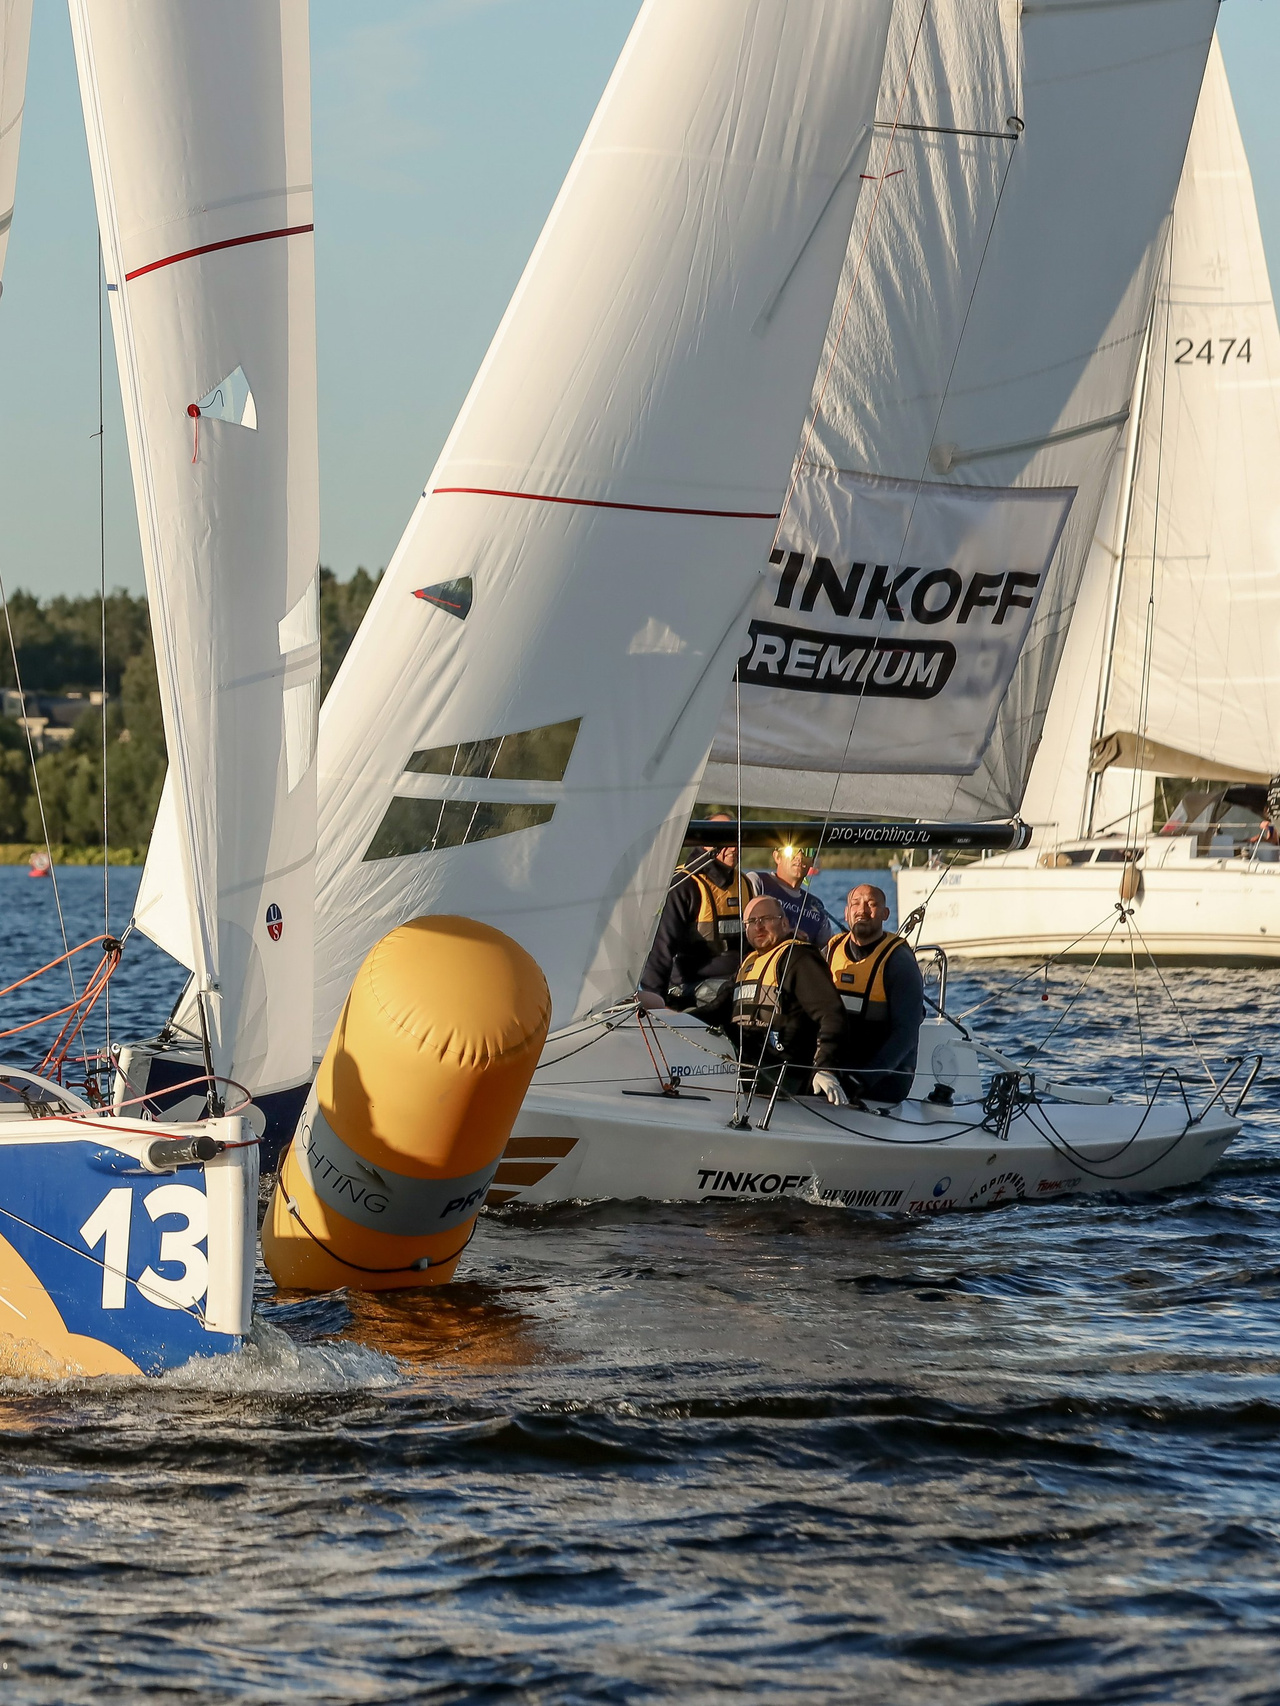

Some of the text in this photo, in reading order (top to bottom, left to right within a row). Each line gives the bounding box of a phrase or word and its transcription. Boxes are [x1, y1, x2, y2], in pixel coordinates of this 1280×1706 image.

[1174, 337, 1252, 365] 2474
[769, 549, 1041, 625] INKOFF
[827, 825, 931, 845] pro-yachting.ru
[300, 1110, 389, 1213] ACHTING
[79, 1184, 208, 1310] 13
